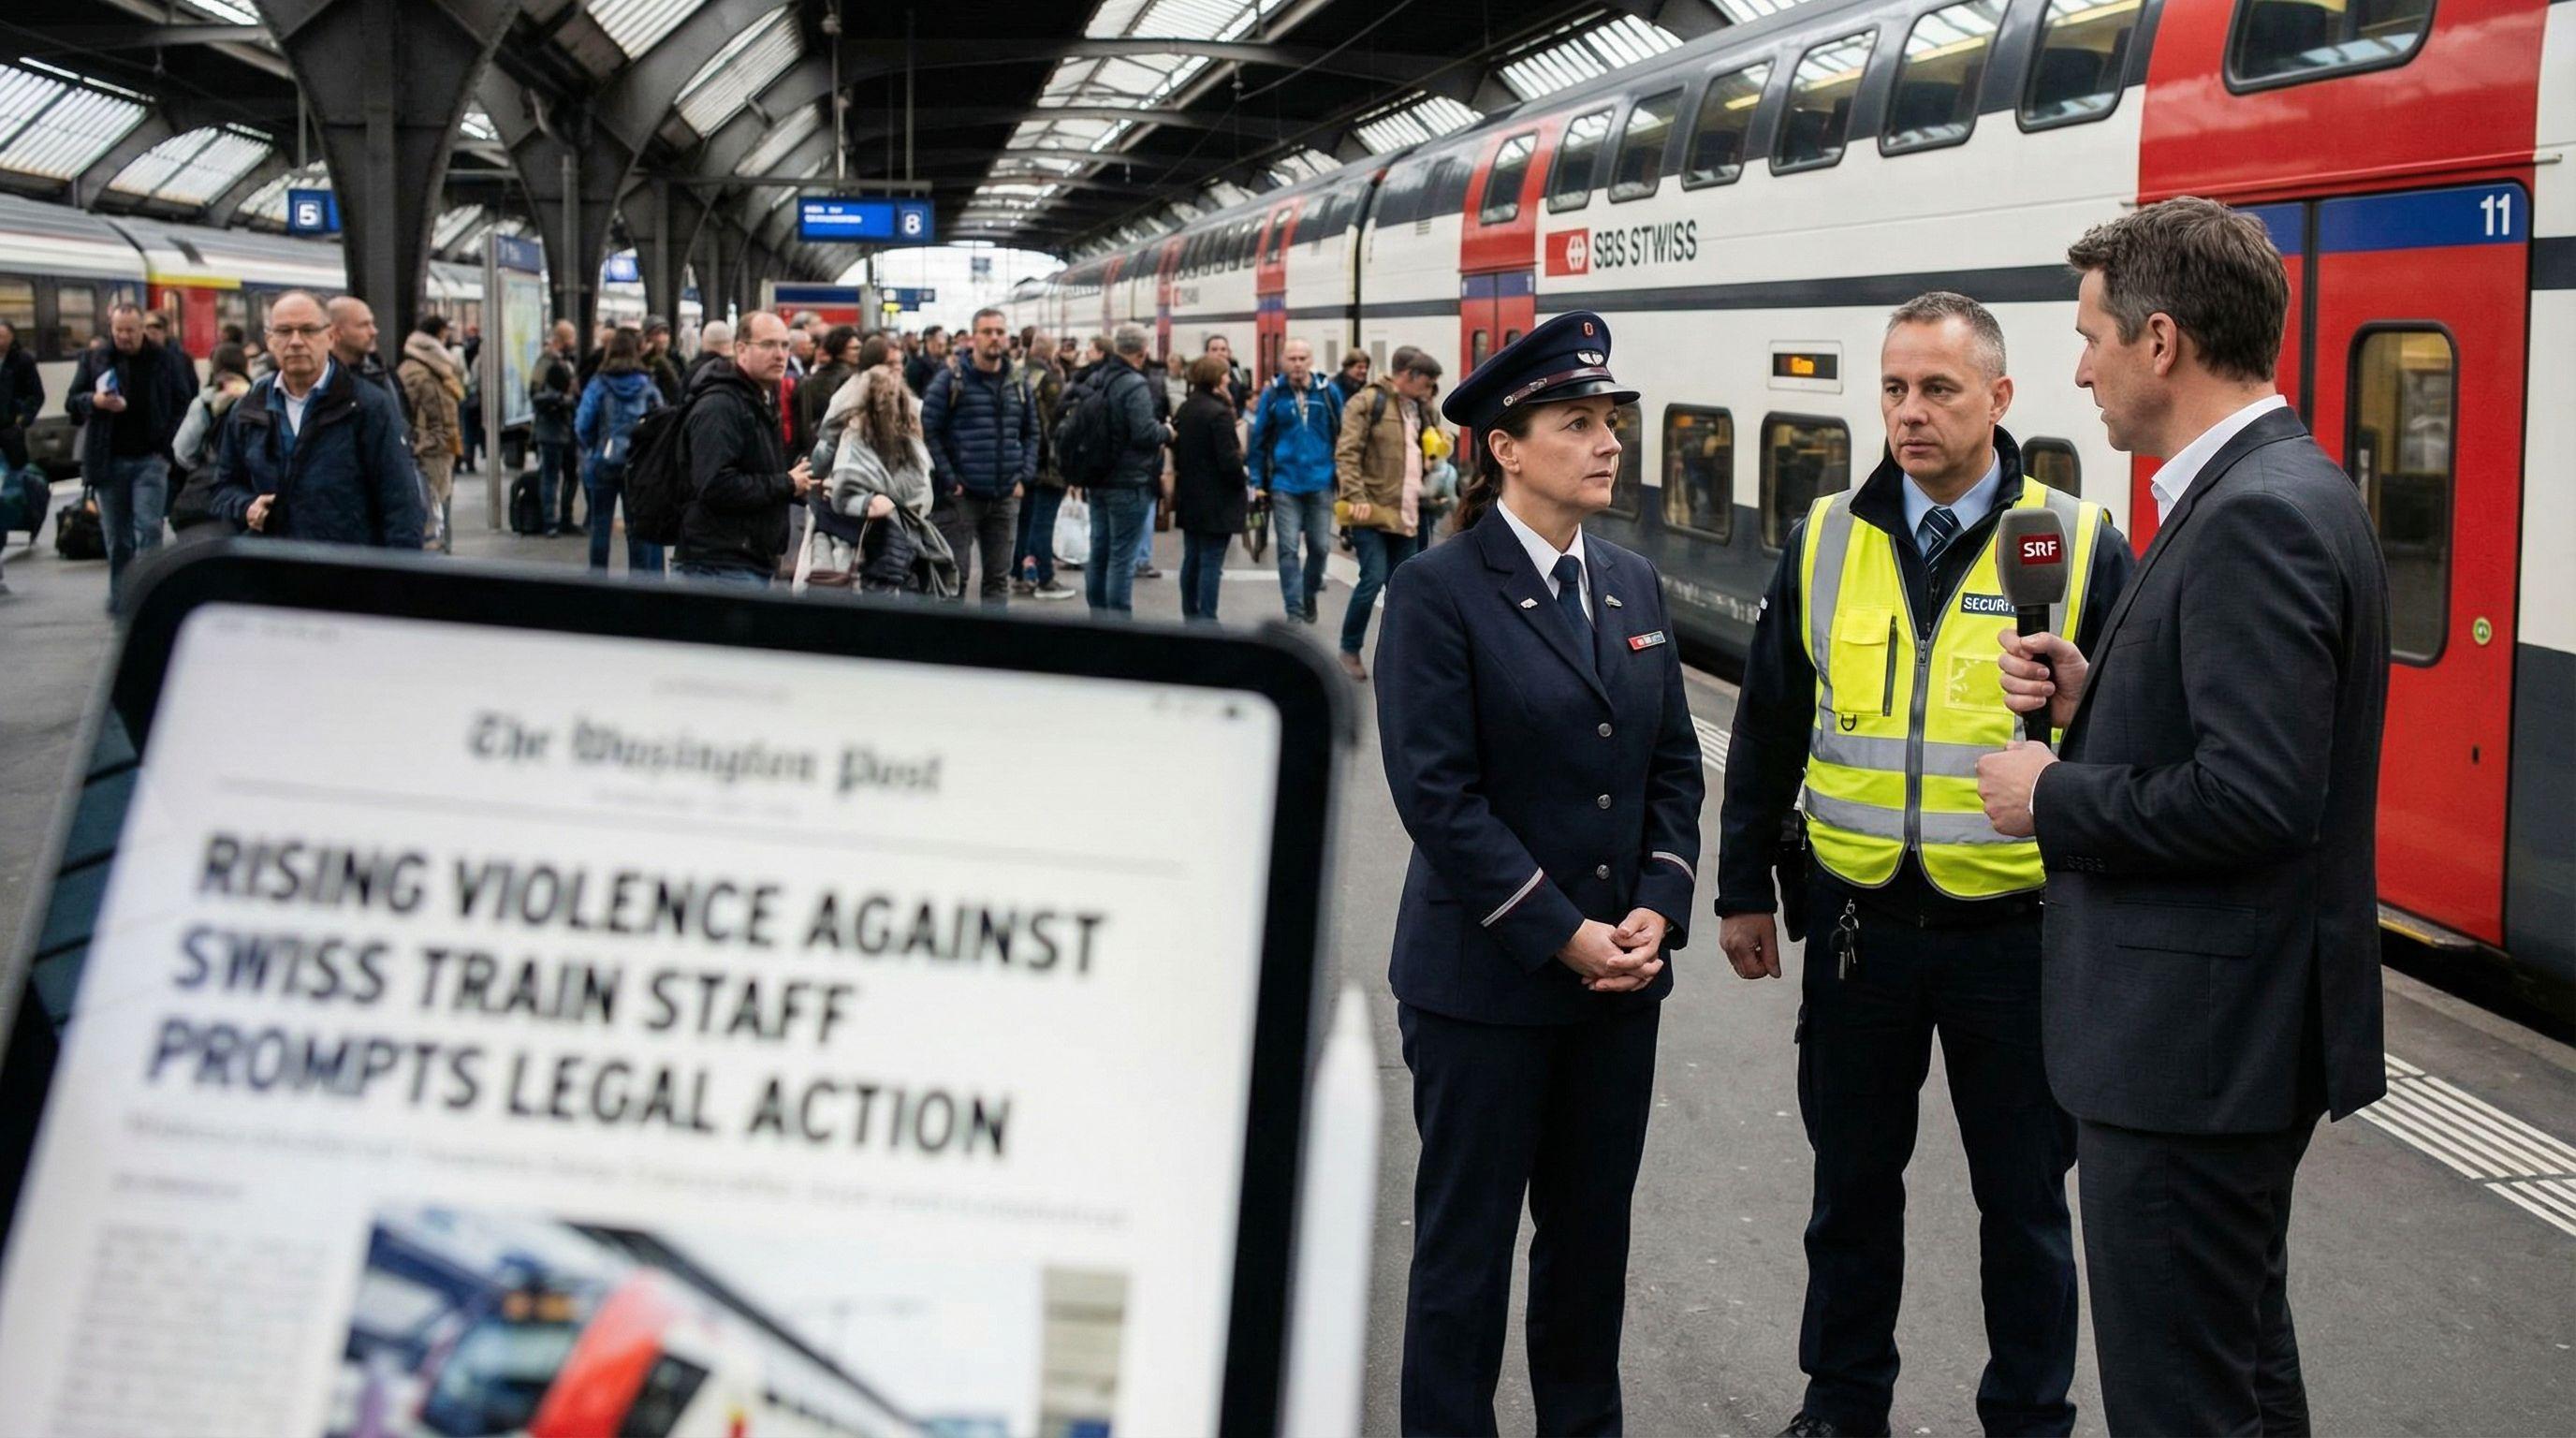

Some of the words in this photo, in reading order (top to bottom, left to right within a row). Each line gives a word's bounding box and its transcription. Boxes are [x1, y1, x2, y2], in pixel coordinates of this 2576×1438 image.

[300, 203, 317, 226] 5
[2480, 193, 2510, 236] 11
[1594, 228, 1626, 269] SBS
[1630, 219, 1697, 266] STWISS
[2023, 540, 2057, 557] SRF
[1963, 596, 2015, 613] SECURI
[198, 832, 428, 916] RISING
[453, 858, 783, 948] VIOLENCE
[804, 891, 1107, 975] AGAINST
[173, 926, 392, 1005] SWISS
[418, 945, 622, 1025] TRAIN
[644, 968, 858, 1045] STAFF
[146, 1016, 484, 1111] PROMPTS
[506, 1048, 717, 1134] LEGAL
[747, 1077, 1012, 1159] ACTION
